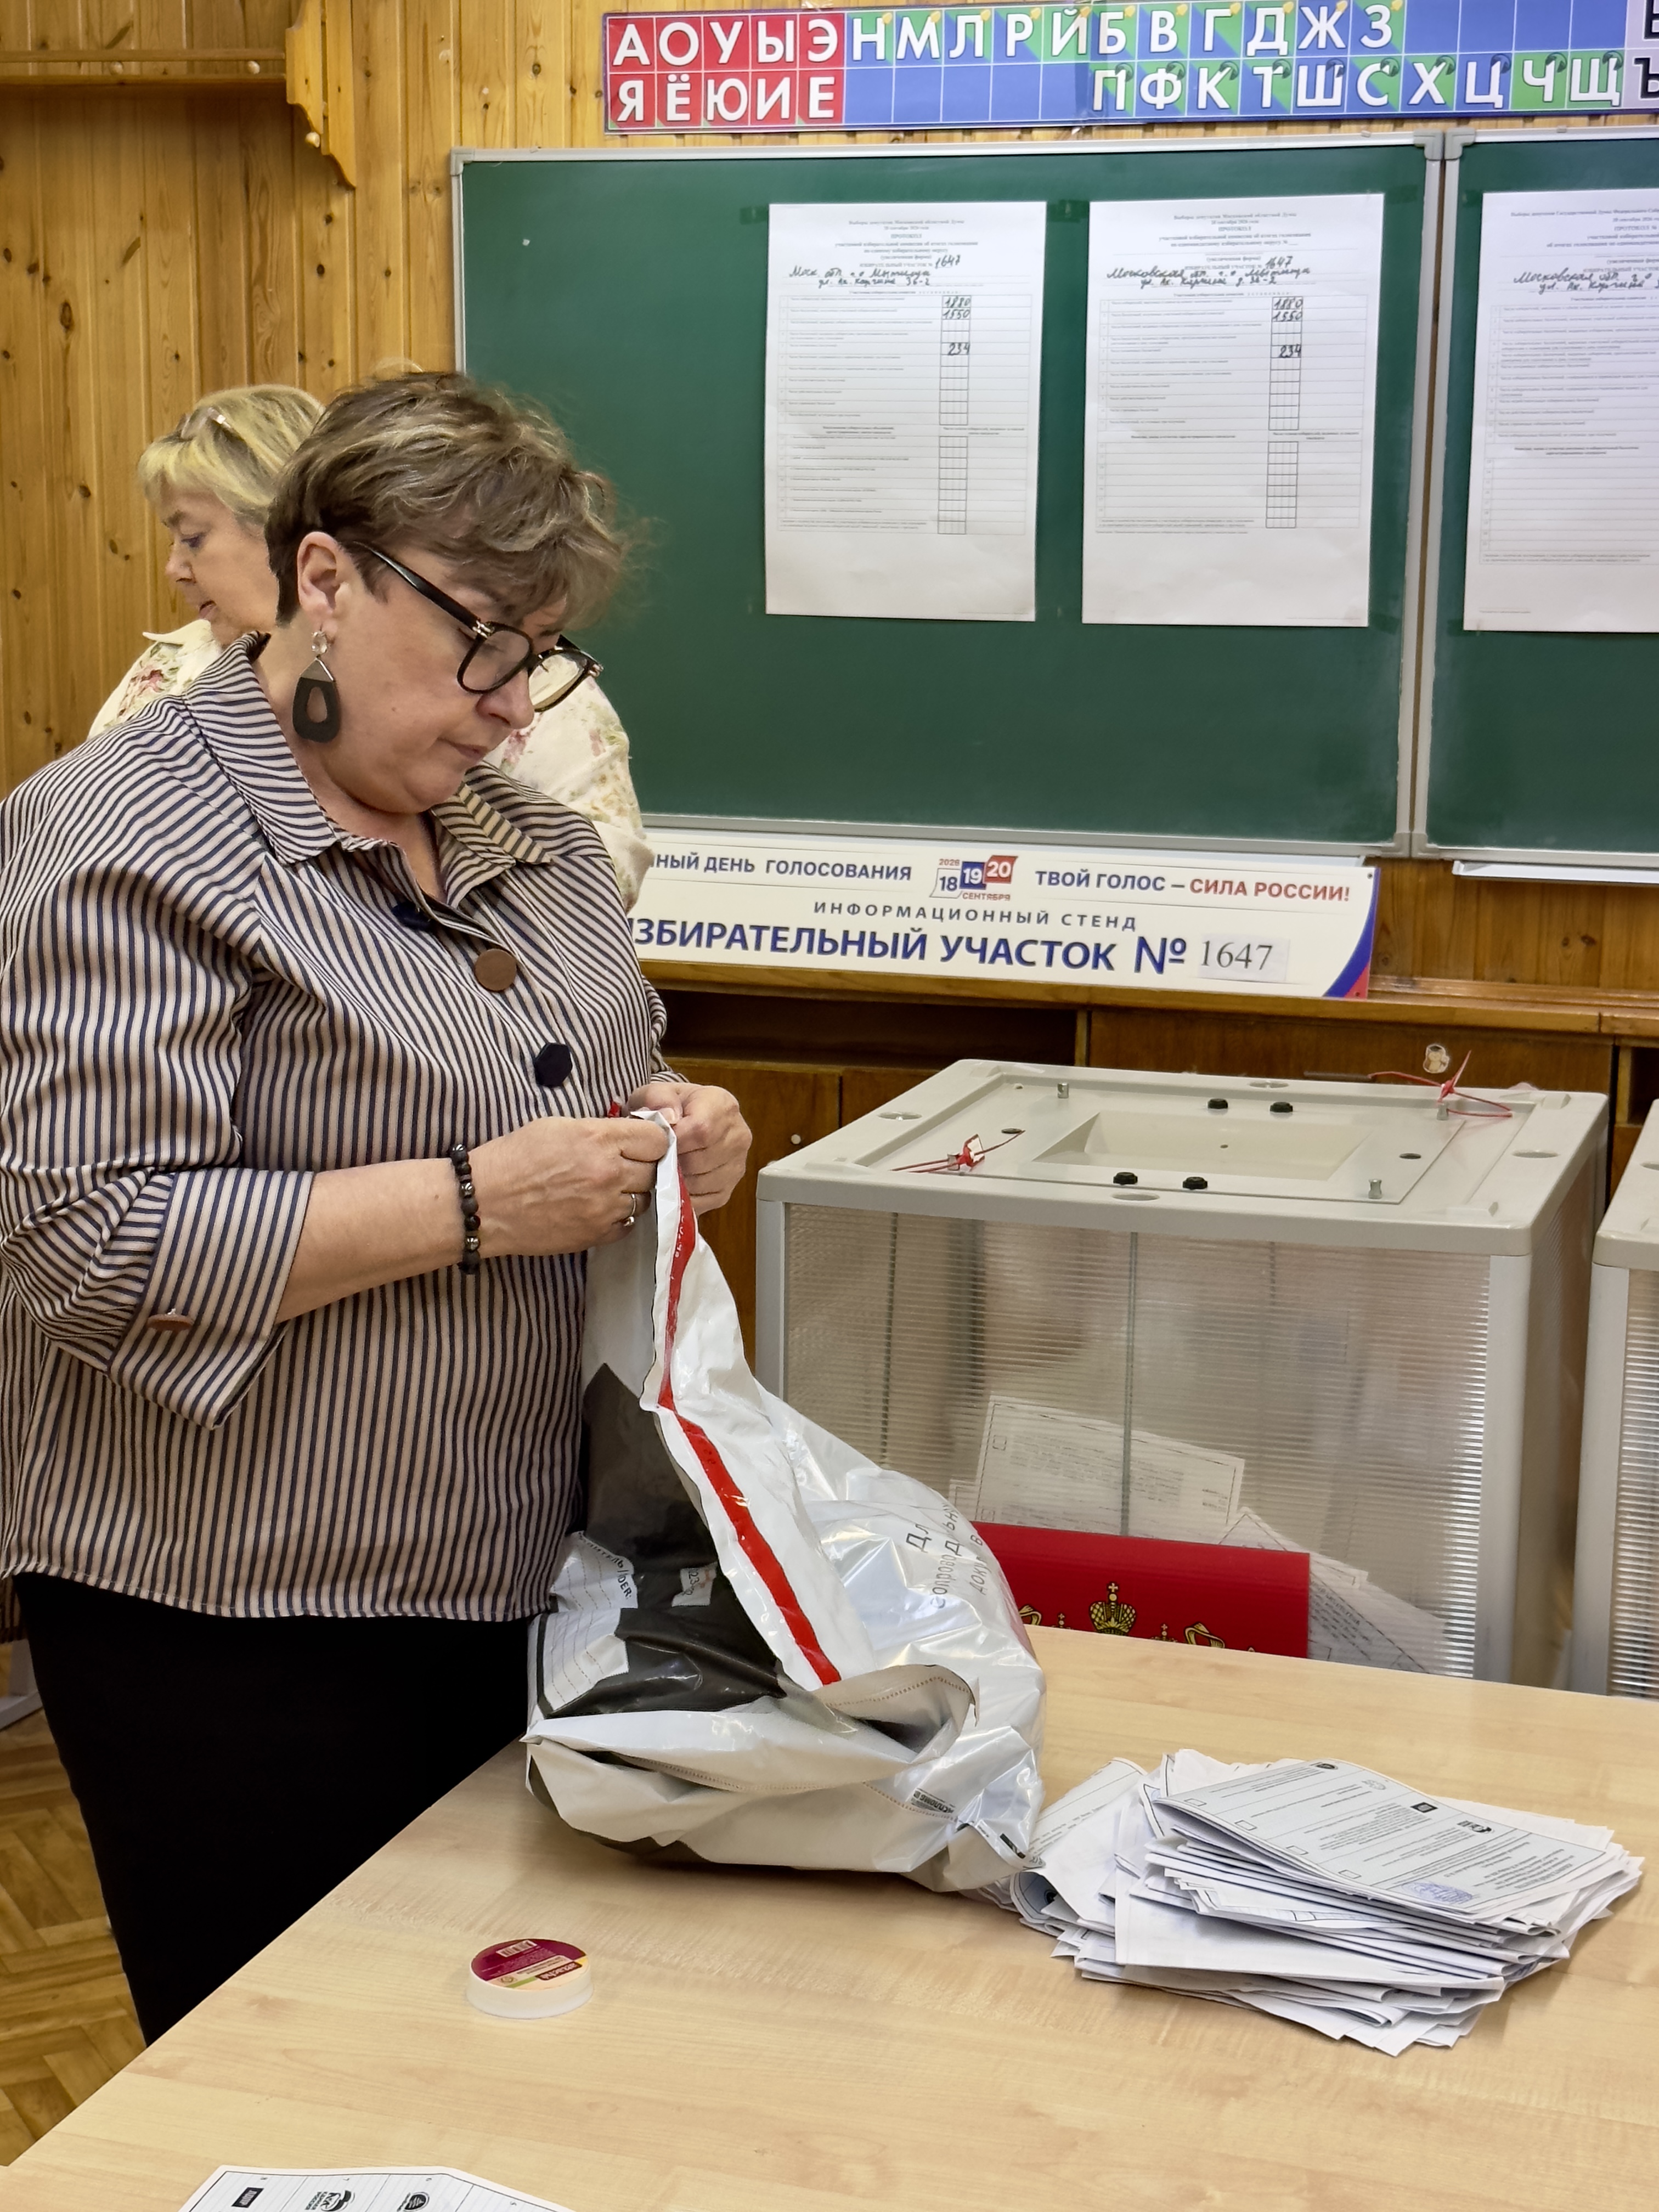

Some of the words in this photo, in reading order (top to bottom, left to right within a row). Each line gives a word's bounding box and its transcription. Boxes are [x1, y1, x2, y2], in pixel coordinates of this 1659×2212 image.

[935, 254, 961, 269] 1647
[1265, 256, 1294, 269] 1647
[1514, 267, 1593, 283] Московская
[943, 308, 970, 319] 1550
[1273, 310, 1302, 321] 1550
[948, 342, 970, 356] 234
[1279, 344, 1302, 358] 234
[652, 852, 699, 871] НЫЙ
[704, 856, 755, 874] ДЕНЬ
[766, 859, 912, 881] ГОЛОСОВАНИЯ
[939, 876, 958, 892] 18
[963, 867, 983, 885] 19
[986, 860, 1012, 878] 20
[1035, 868, 1091, 889] ТВОЙ
[1095, 872, 1166, 892] ГОЛОС
[1189, 878, 1247, 898] СИЛА
[1254, 882, 1351, 902] РОССИИ!
[962, 892, 1011, 901] СЕНТЯБРЯ
[814, 901, 1049, 925] ИНФОРМАЦИОННЫЙ
[1061, 913, 1136, 932] СТЕНД
[940, 934, 1117, 971] УЧАСТОК
[1133, 935, 1187, 975] №
[1200, 939, 1274, 971] 1647
